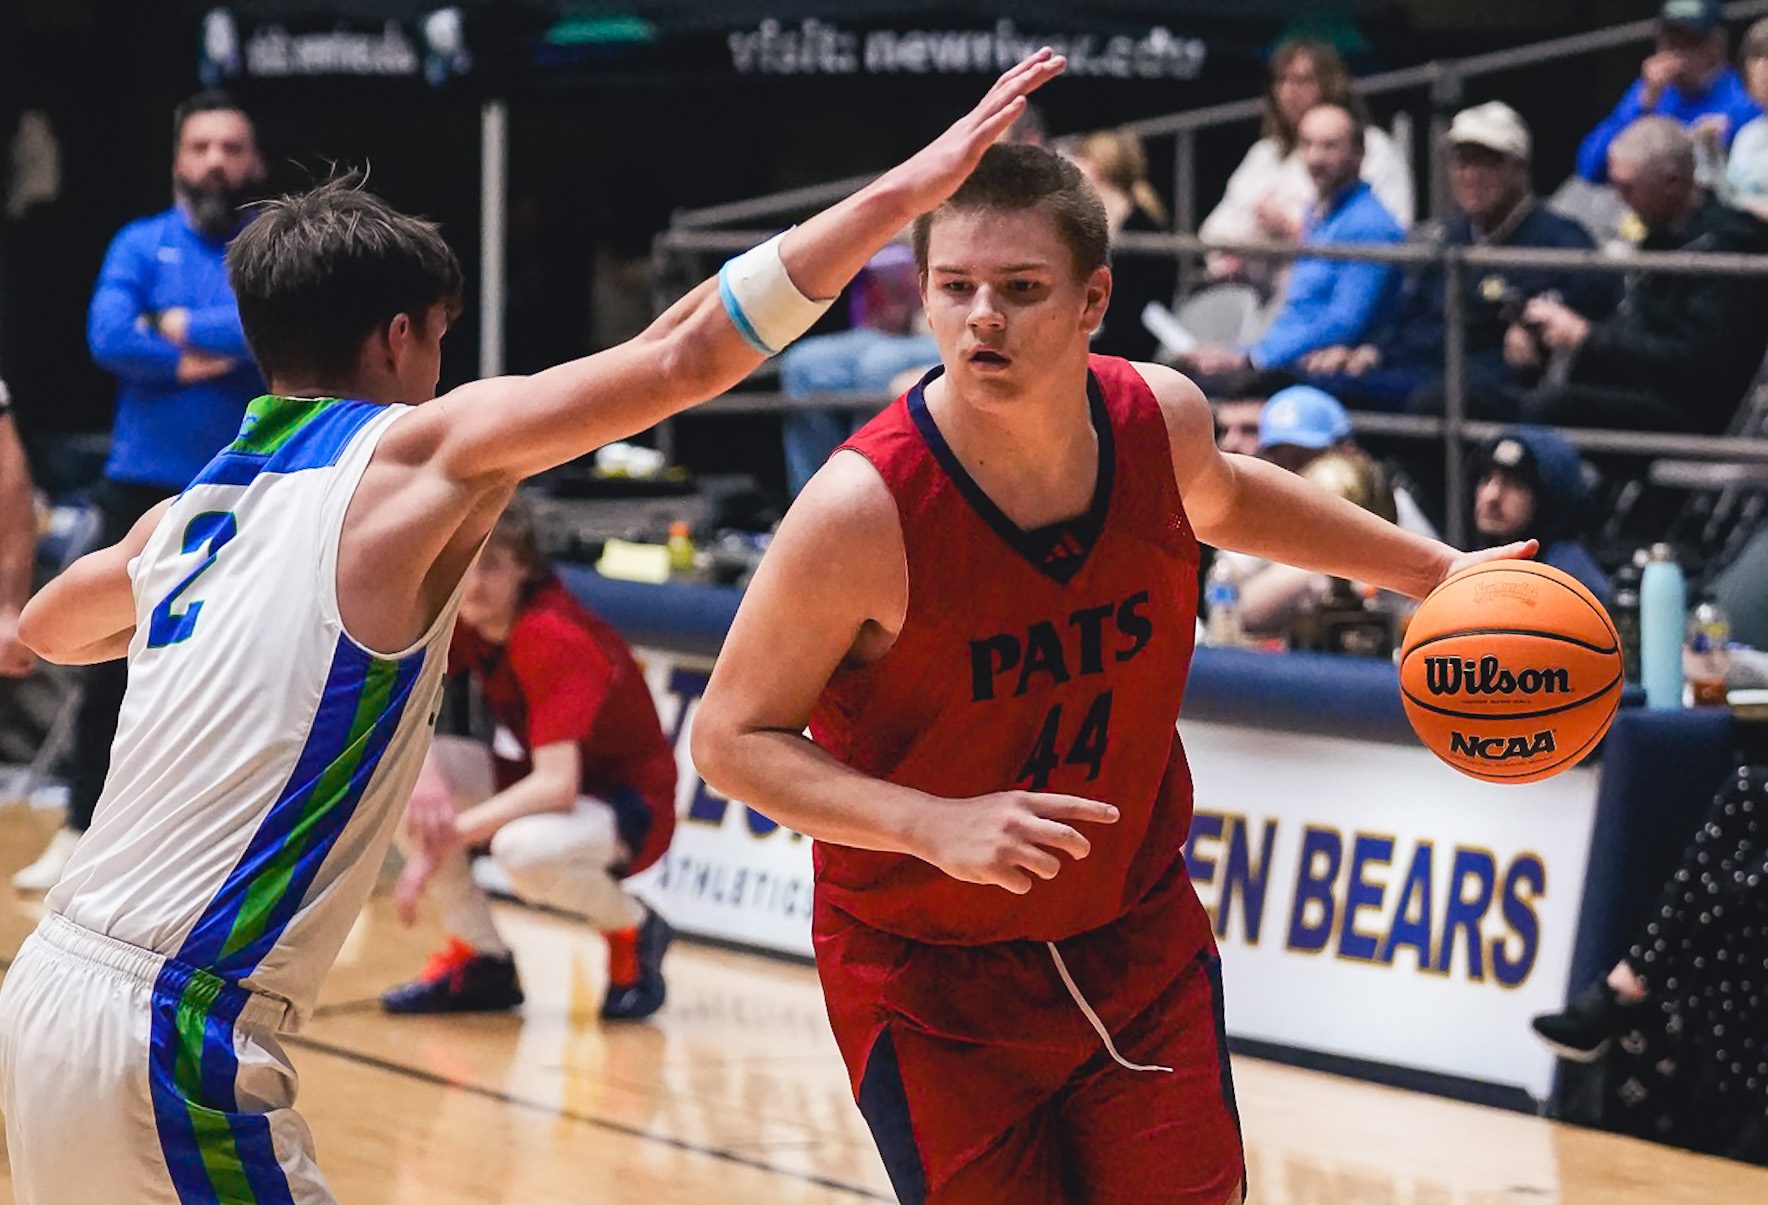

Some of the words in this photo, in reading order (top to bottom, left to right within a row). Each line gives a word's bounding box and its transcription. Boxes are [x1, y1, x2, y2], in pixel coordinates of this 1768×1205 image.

[147, 510, 238, 649] 2
[969, 590, 1153, 702] PATS
[1424, 654, 1572, 697] Wilson
[1016, 688, 1113, 792] 44
[1450, 729, 1556, 761] NCAA
[1286, 825, 1547, 989] BEARS
